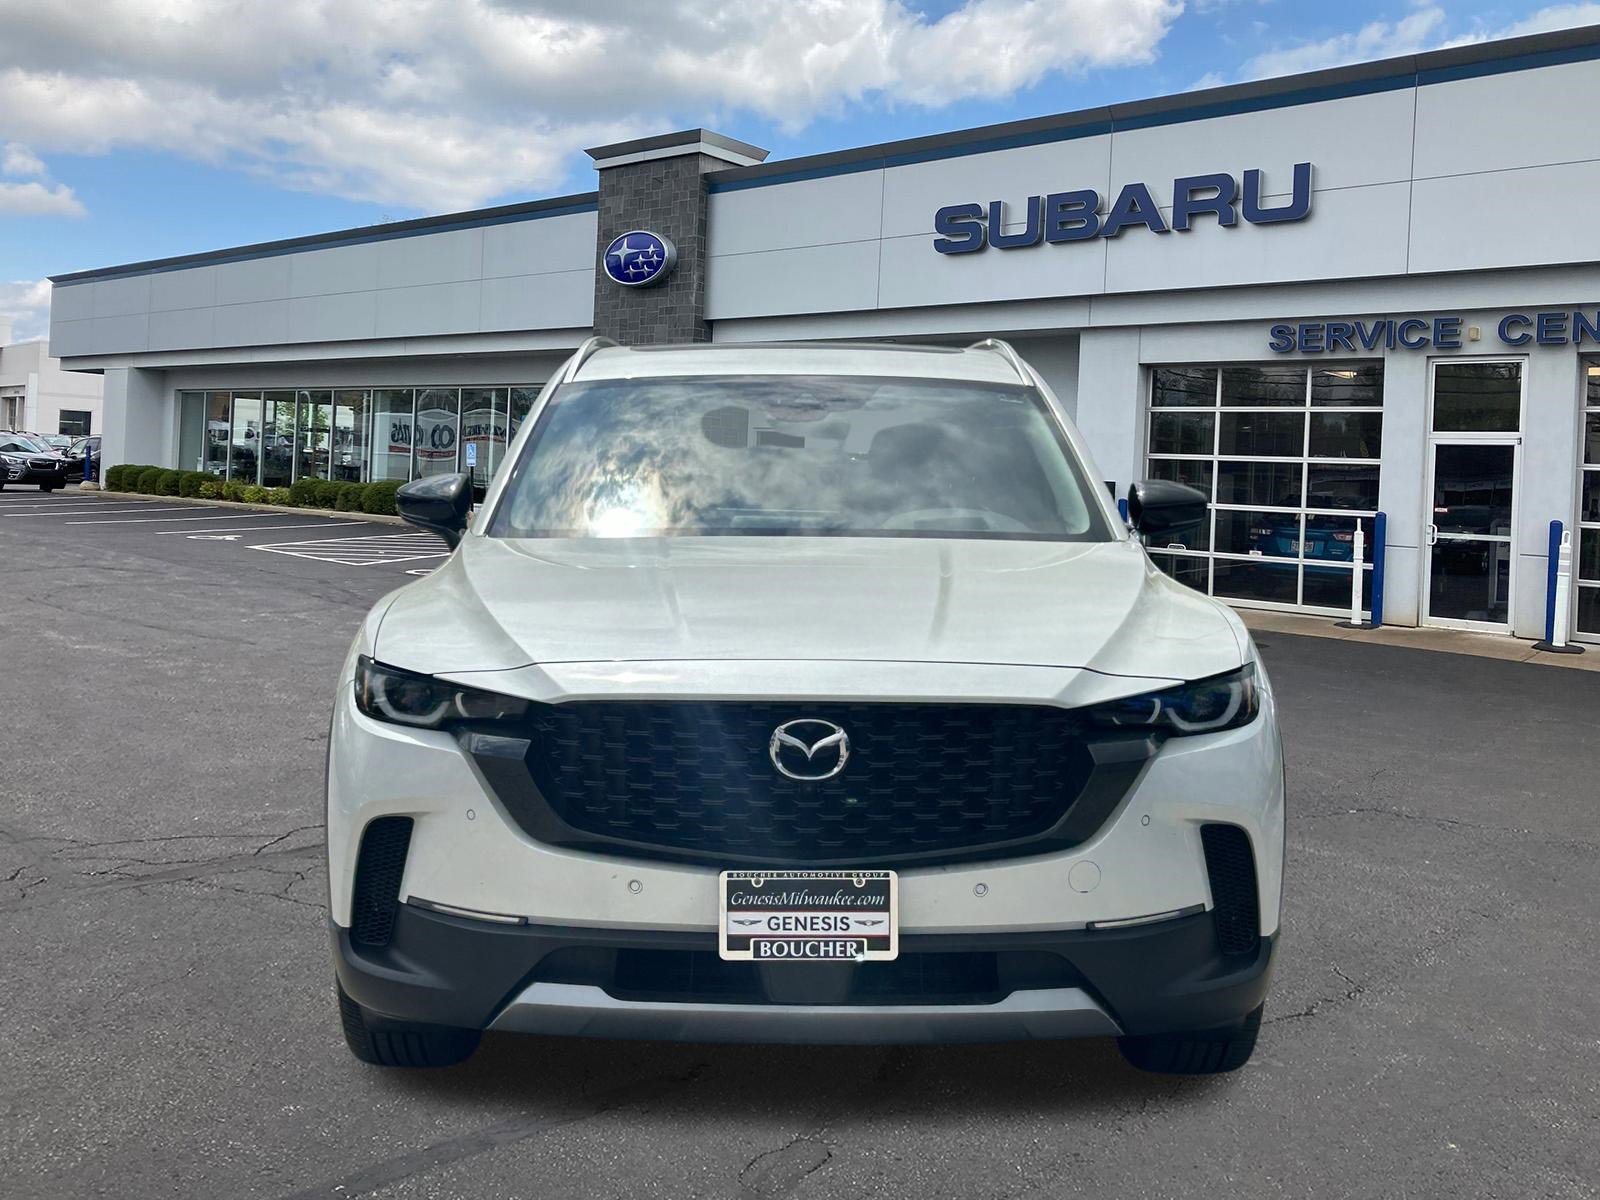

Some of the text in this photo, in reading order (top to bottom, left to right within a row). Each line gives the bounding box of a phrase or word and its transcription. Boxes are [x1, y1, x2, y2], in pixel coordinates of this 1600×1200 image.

[933, 161, 1315, 255] SUBARU
[1268, 311, 1600, 353] SERVICE CEN
[731, 889, 885, 907] GenesisMilwaukee.com
[767, 916, 851, 931] GENESIS
[760, 941, 859, 957] BOUCHER
